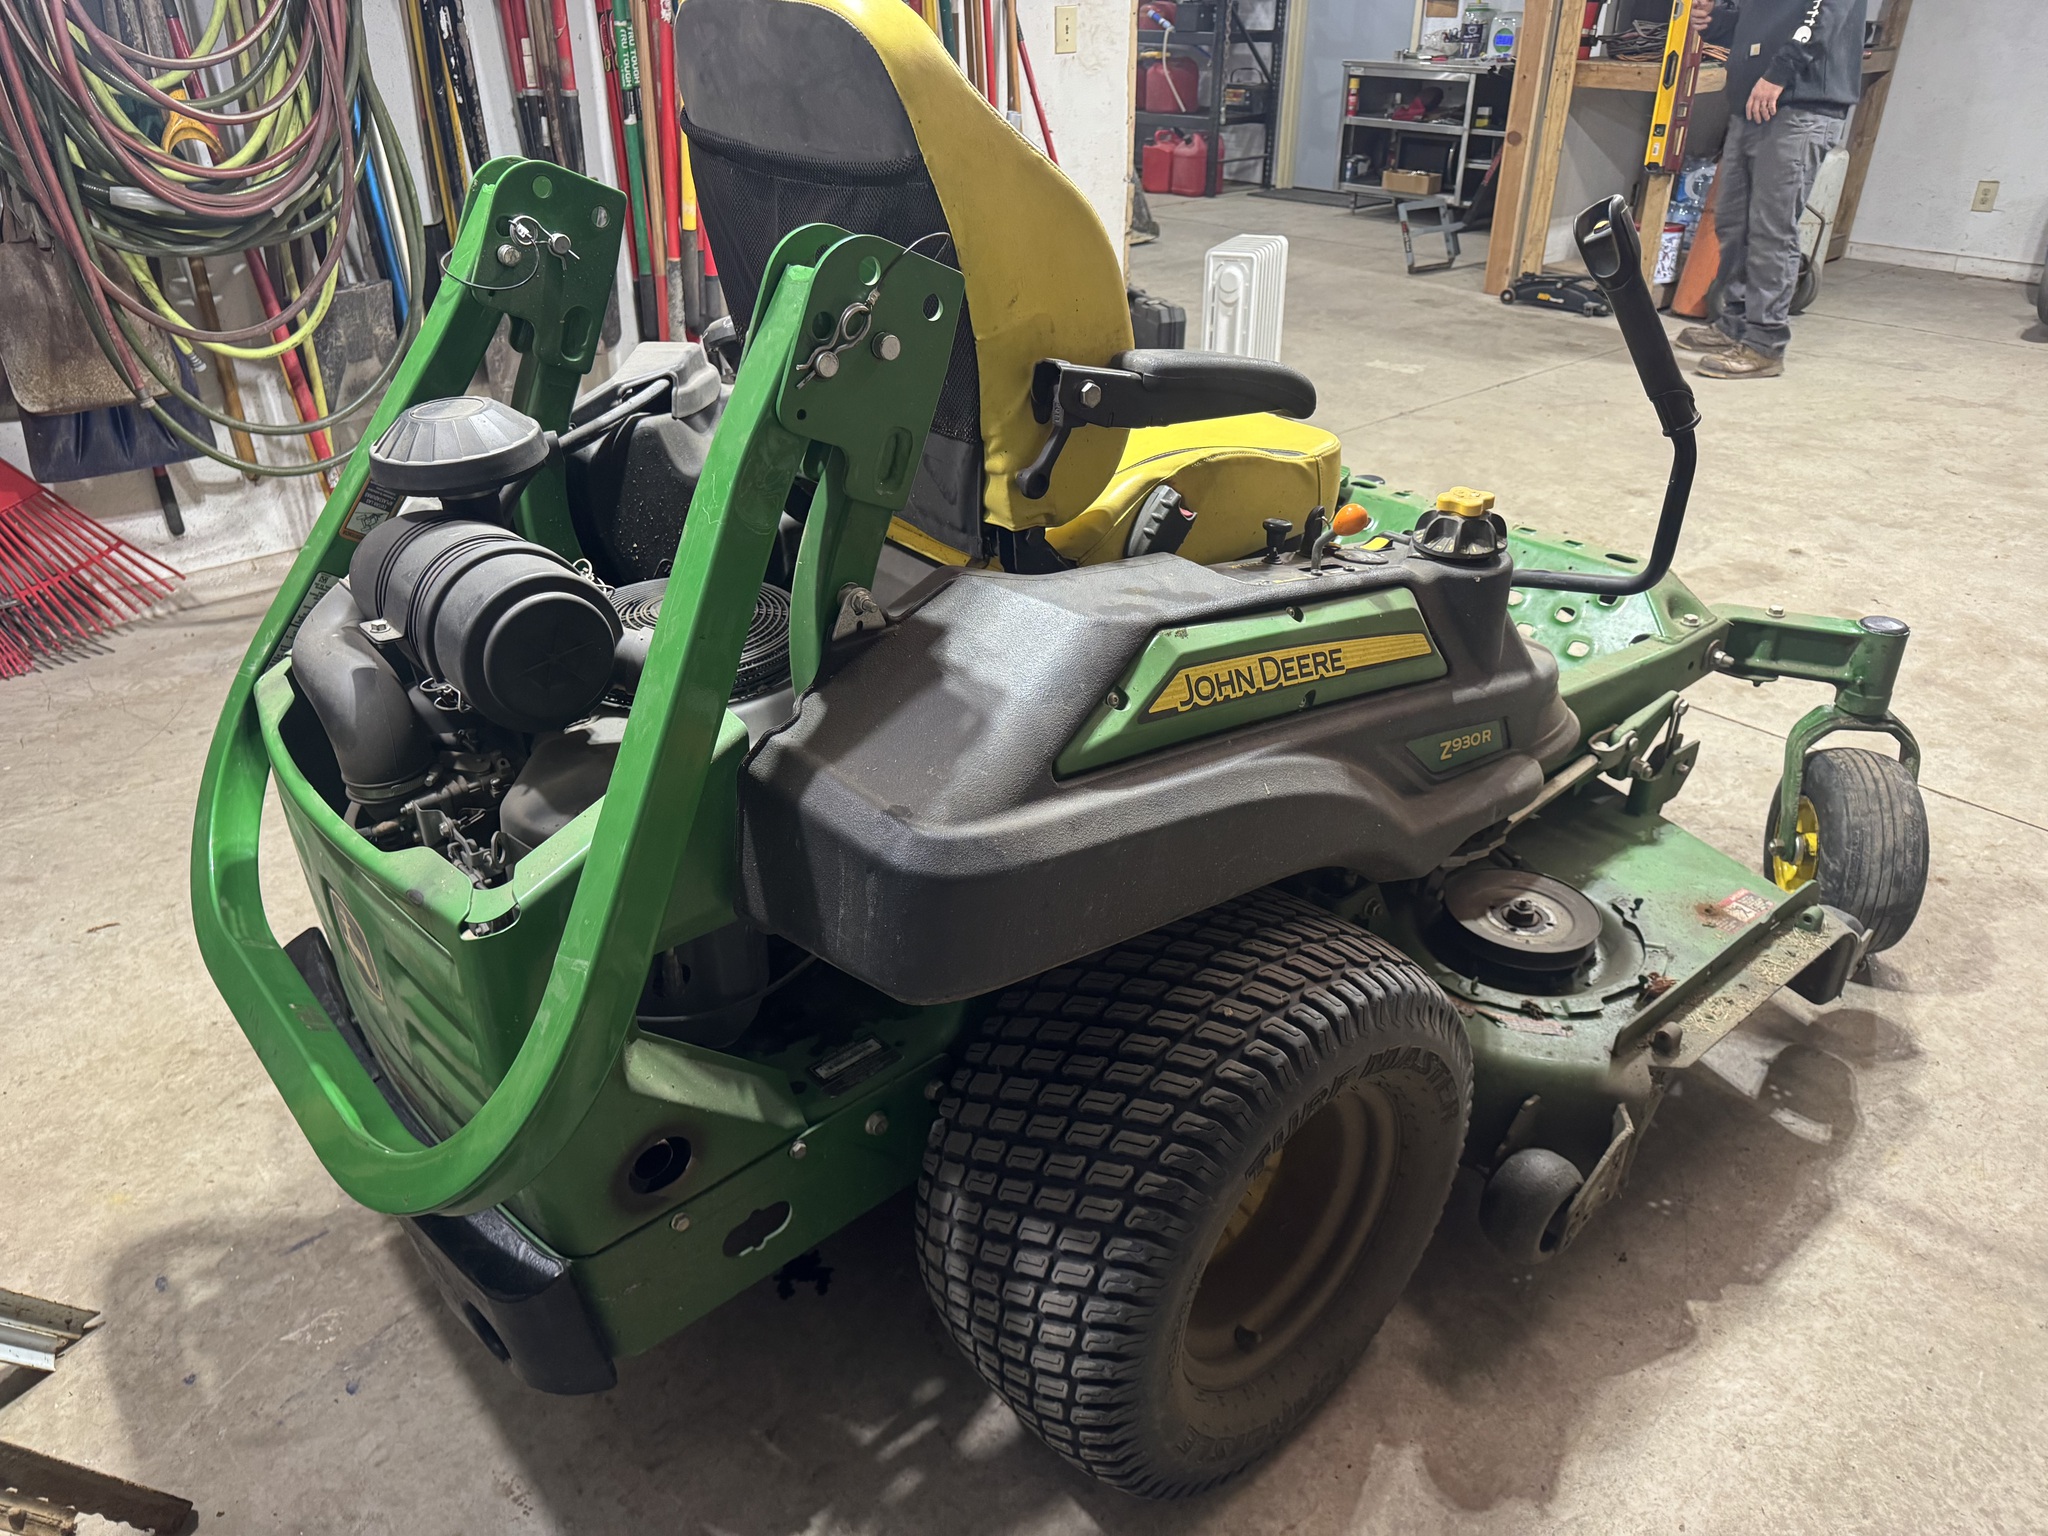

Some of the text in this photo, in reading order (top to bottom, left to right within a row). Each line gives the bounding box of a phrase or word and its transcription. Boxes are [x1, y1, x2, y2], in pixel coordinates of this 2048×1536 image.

[623, 52, 633, 88] TOUGH
[627, 25, 640, 84] TRU TOUGH
[1179, 647, 1347, 709] JOHN DEERE
[1440, 728, 1492, 761] Z930R
[1357, 1043, 1461, 1125] MASTER
